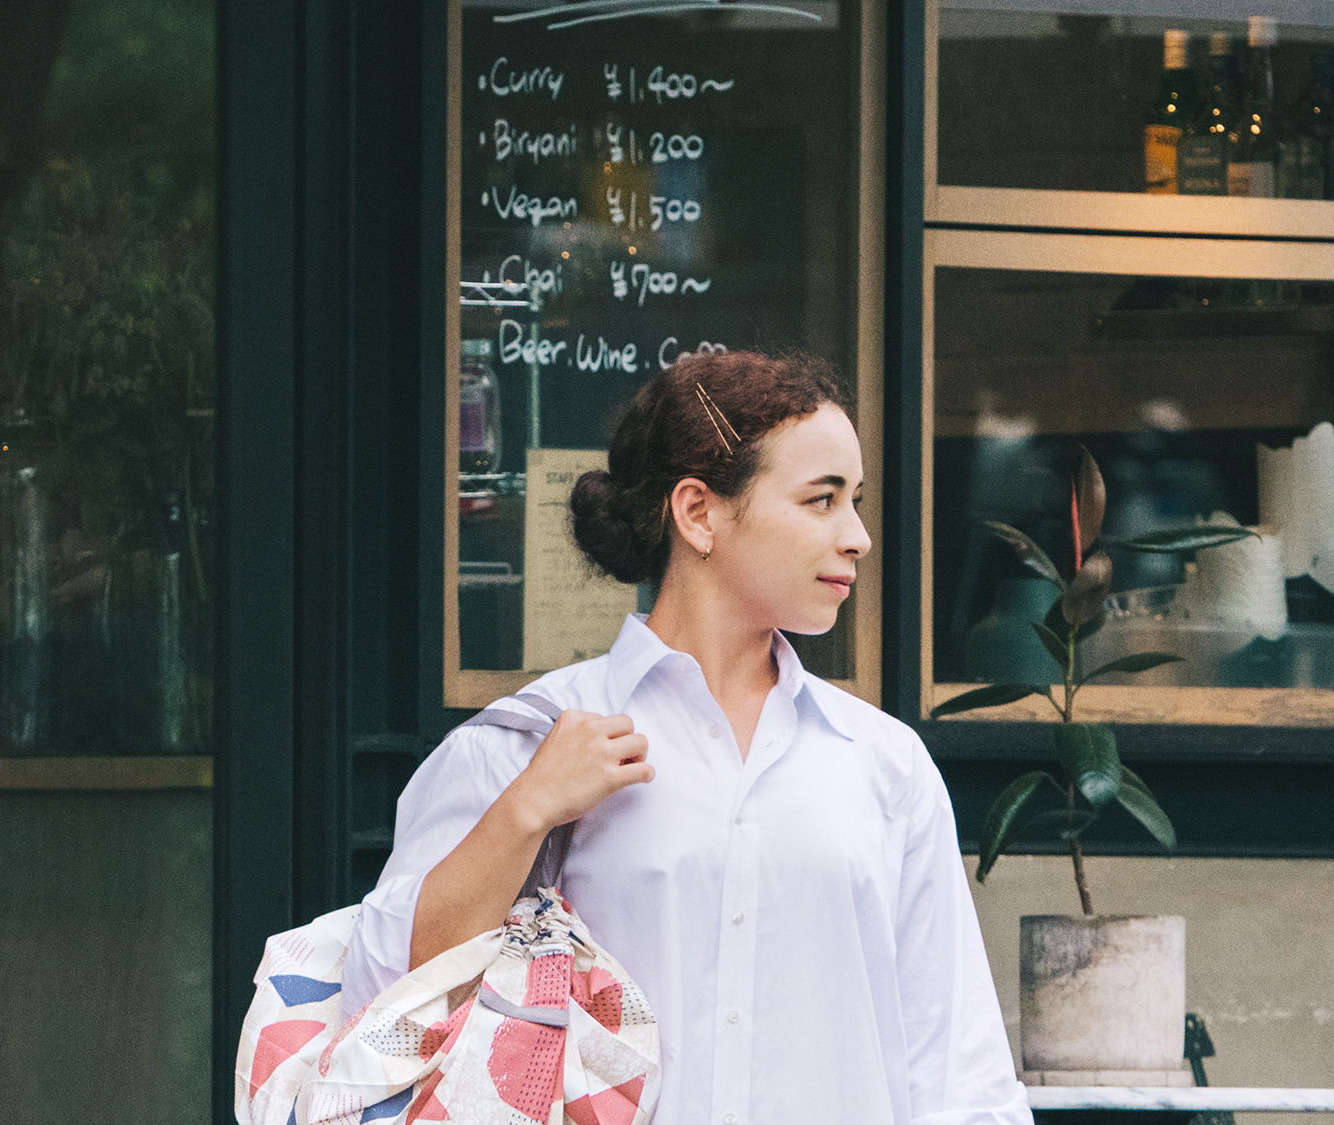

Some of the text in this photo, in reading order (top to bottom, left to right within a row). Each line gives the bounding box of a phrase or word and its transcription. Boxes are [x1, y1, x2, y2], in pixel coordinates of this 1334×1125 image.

[490, 57, 565, 100] Curry
[494, 119, 577, 165] Biryani
[492, 185, 577, 227] Vegan
[499, 255, 563, 295] Chai
